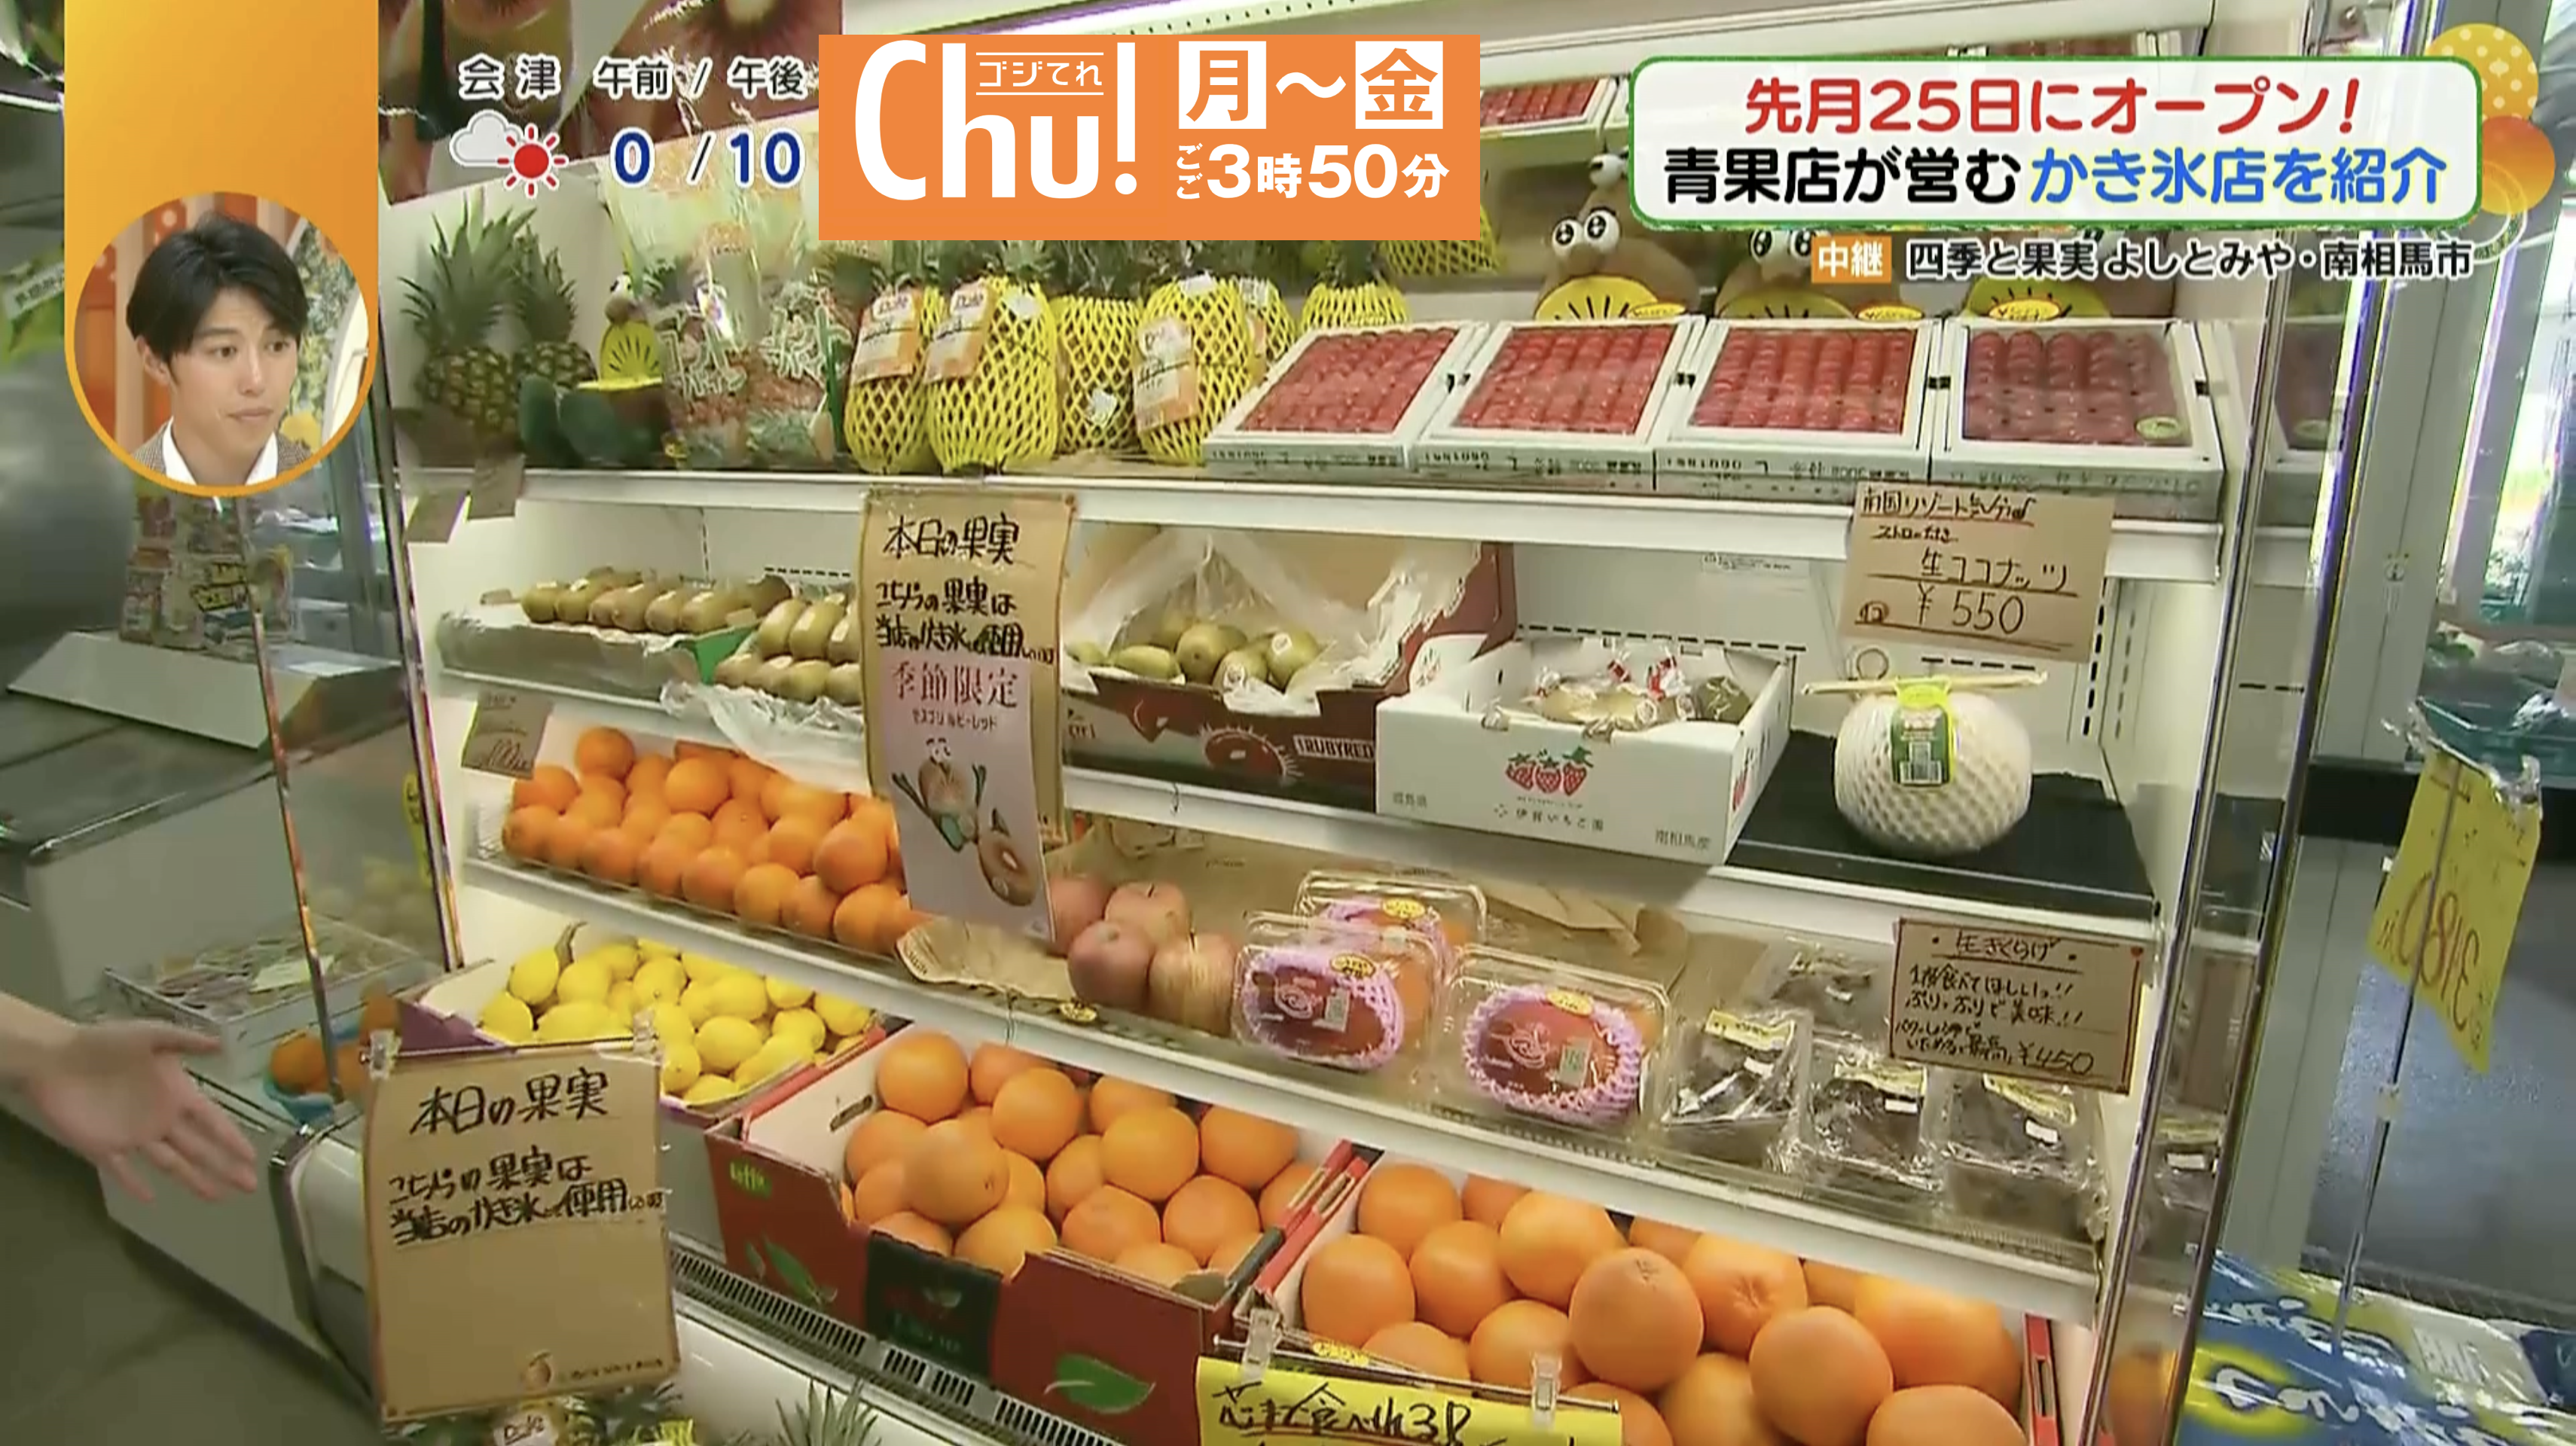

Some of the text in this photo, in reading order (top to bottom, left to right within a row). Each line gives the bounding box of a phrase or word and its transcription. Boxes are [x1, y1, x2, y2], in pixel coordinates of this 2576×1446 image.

[883, 512, 1020, 565] 本日の果実
[1921, 547, 2068, 592] 生ココナッツ
[892, 660, 1018, 708] 季節限定
[409, 1067, 609, 1135] 本日の果実
[388, 1145, 593, 1205] こちらの果実は
